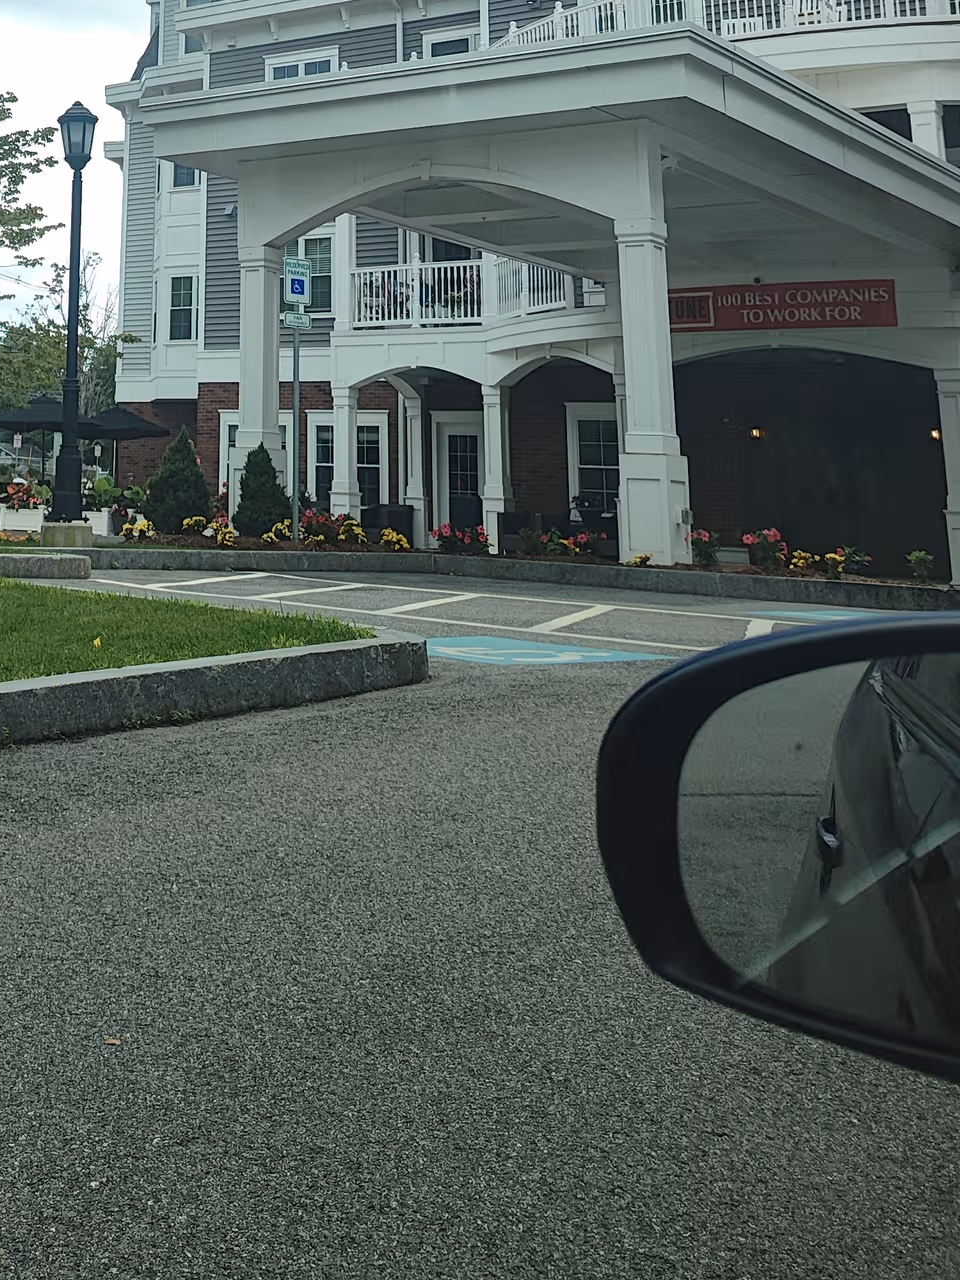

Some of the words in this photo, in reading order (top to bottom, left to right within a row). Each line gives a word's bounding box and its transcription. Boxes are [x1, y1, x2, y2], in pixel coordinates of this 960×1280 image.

[717, 293, 741, 307] 100
[745, 291, 780, 306] BEST
[785, 287, 889, 305] COMPANIES
[740, 309, 764, 323] TO
[767, 308, 822, 322] WORK
[825, 306, 862, 321] FOR
